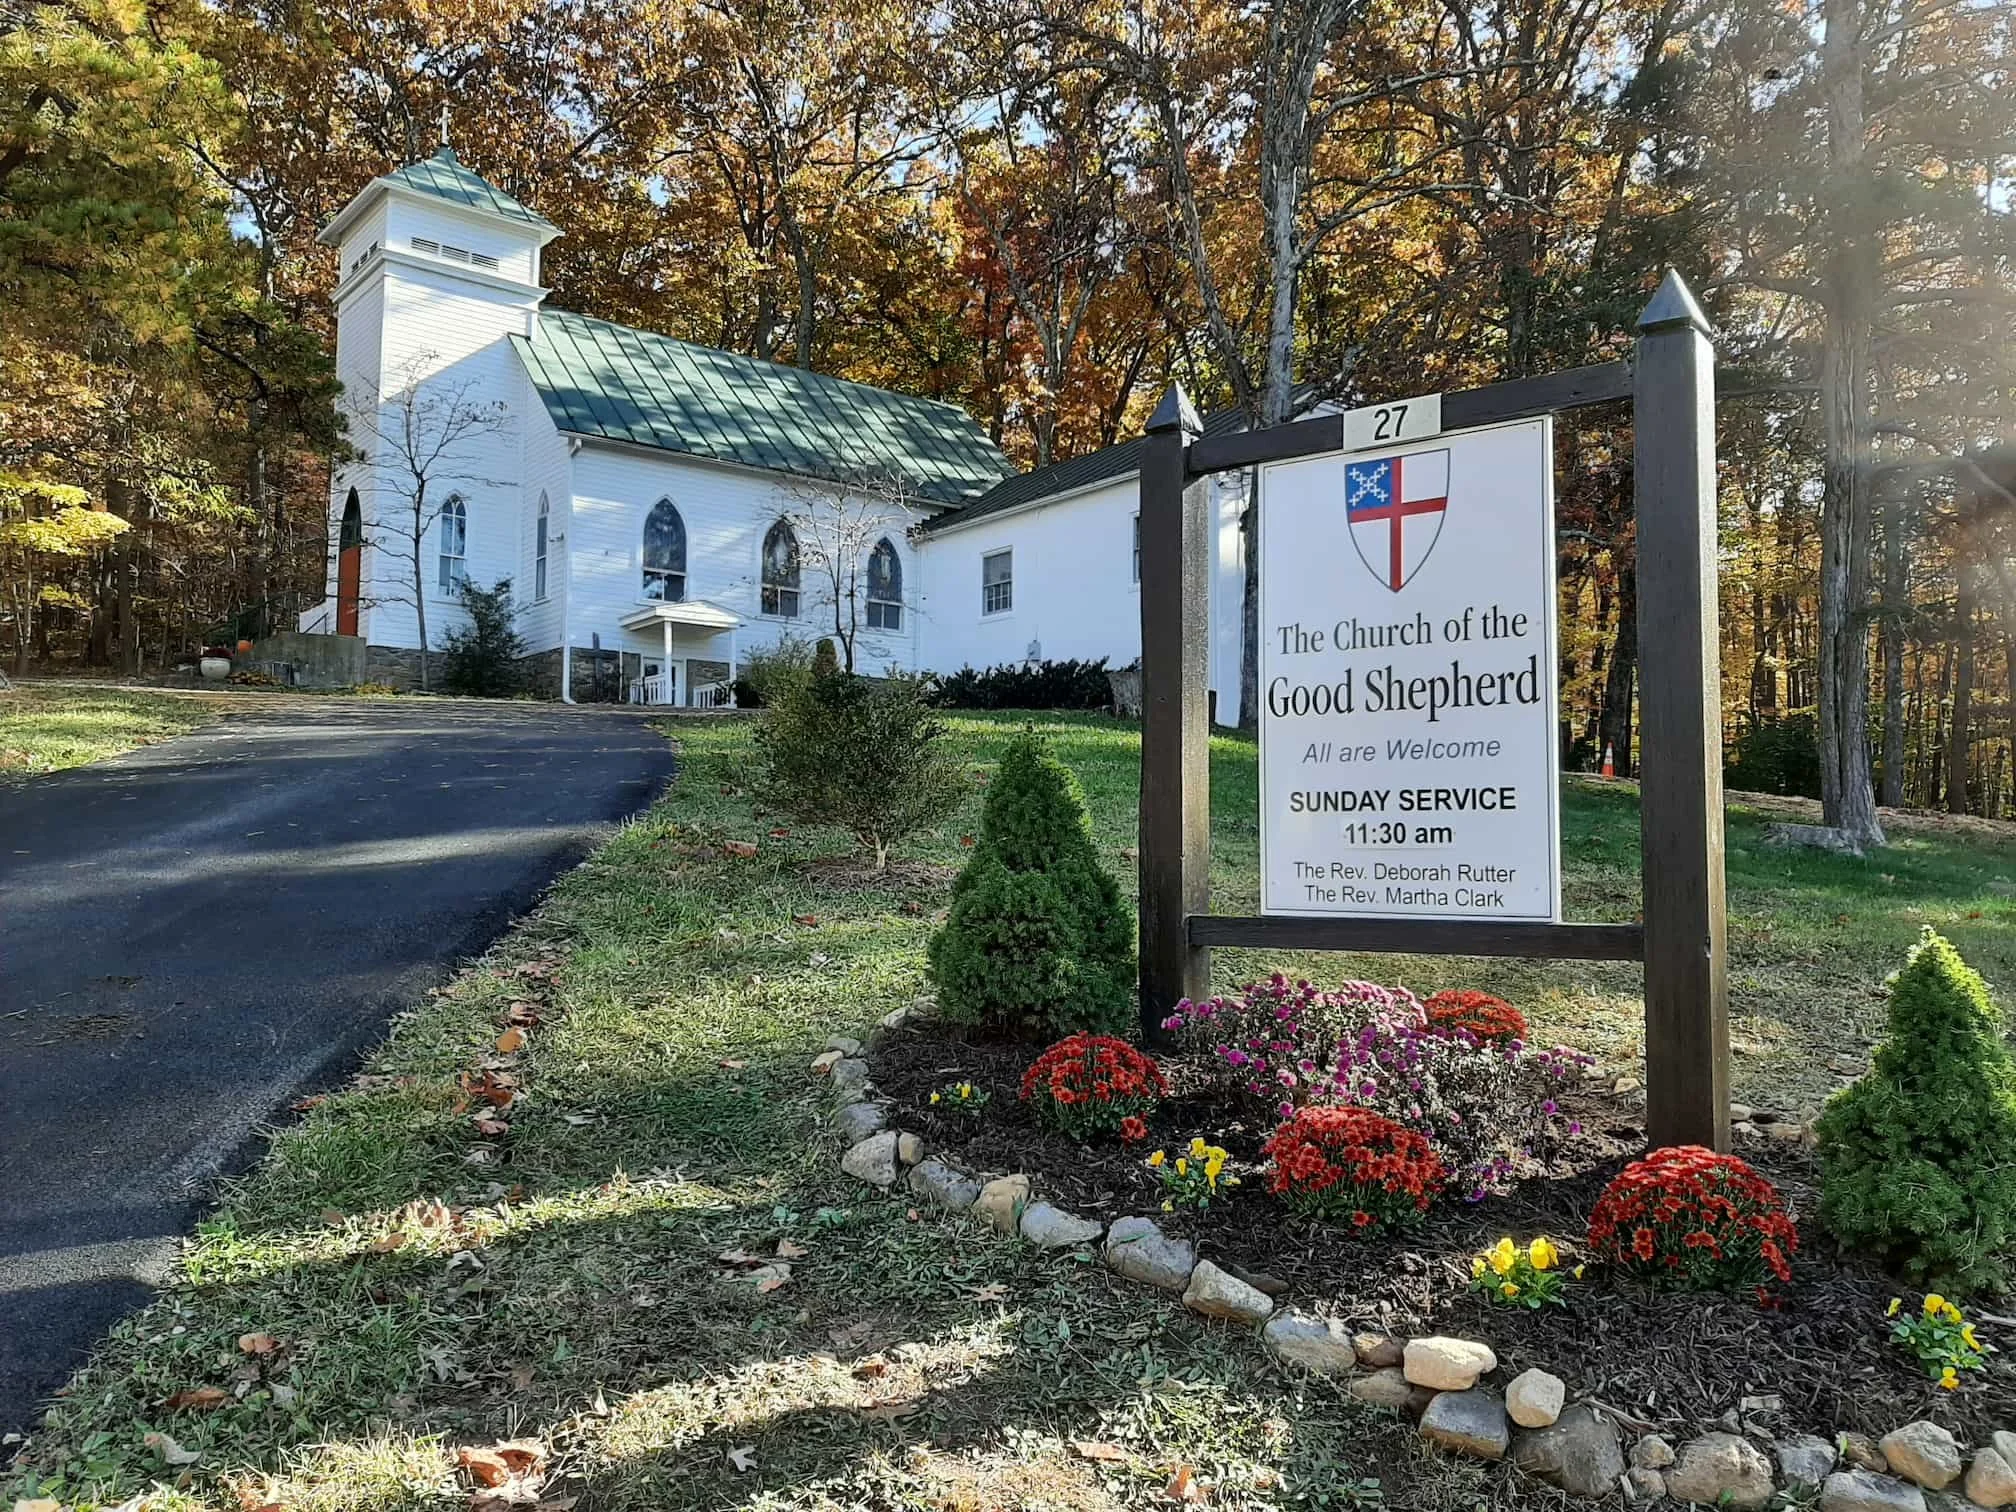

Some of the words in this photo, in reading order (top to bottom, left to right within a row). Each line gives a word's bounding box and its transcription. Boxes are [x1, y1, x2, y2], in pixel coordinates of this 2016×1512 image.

[1374, 405, 1408, 440] 27
[1278, 623, 1324, 654] The
[1334, 612, 1432, 650] Church
[1444, 607, 1473, 642] of
[1482, 605, 1527, 639] the
[1269, 668, 1354, 717] Good
[1366, 654, 1540, 722] Shepherd
[1303, 743, 1331, 763] All
[1340, 746, 1375, 762] are
[1387, 738, 1500, 760] Welcome
[1291, 790, 1390, 812] SUNDAY
[1399, 787, 1516, 811] SERVICE
[1346, 823, 1406, 844] 11:30
[1415, 827, 1452, 843] am
[1293, 862, 1324, 879] The
[1331, 863, 1367, 879] Rev.
[1375, 863, 1450, 881] Deborah
[1458, 864, 1516, 882] Rutter
[1304, 885, 1336, 902] The
[1343, 886, 1379, 903] Rev.
[1386, 887, 1448, 905] Martha
[1455, 889, 1504, 907] Clark
